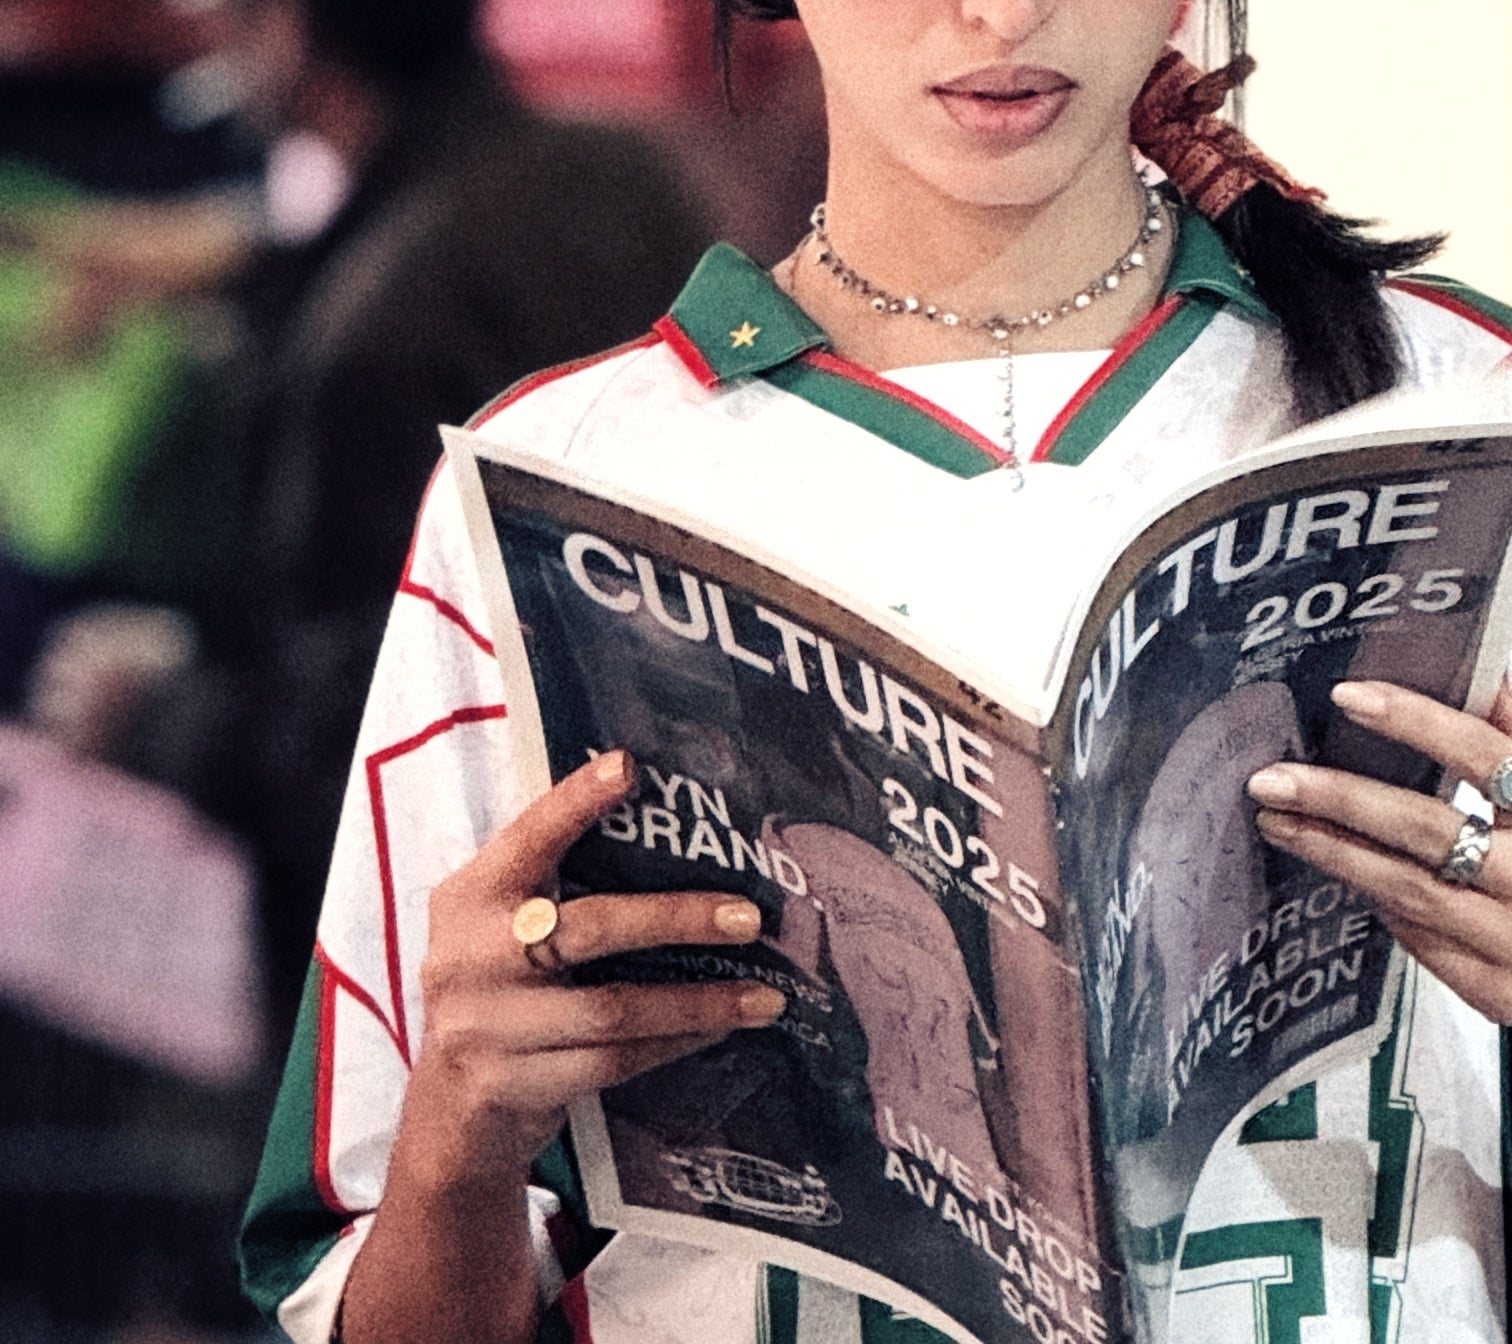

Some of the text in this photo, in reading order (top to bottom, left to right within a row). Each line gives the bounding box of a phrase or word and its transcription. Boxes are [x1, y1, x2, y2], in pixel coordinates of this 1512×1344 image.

[1072, 479, 1450, 780] CULTURE
[1240, 567, 1466, 652] 2025
[563, 532, 1003, 819] CULTURE
[600, 800, 808, 897] BRAND
[882, 776, 1047, 929] 2025
[1241, 881, 1358, 967] DRO
[1230, 948, 1364, 1058] SOON
[884, 1105, 980, 1205] LIVE
[984, 1186, 1102, 1293] DROP
